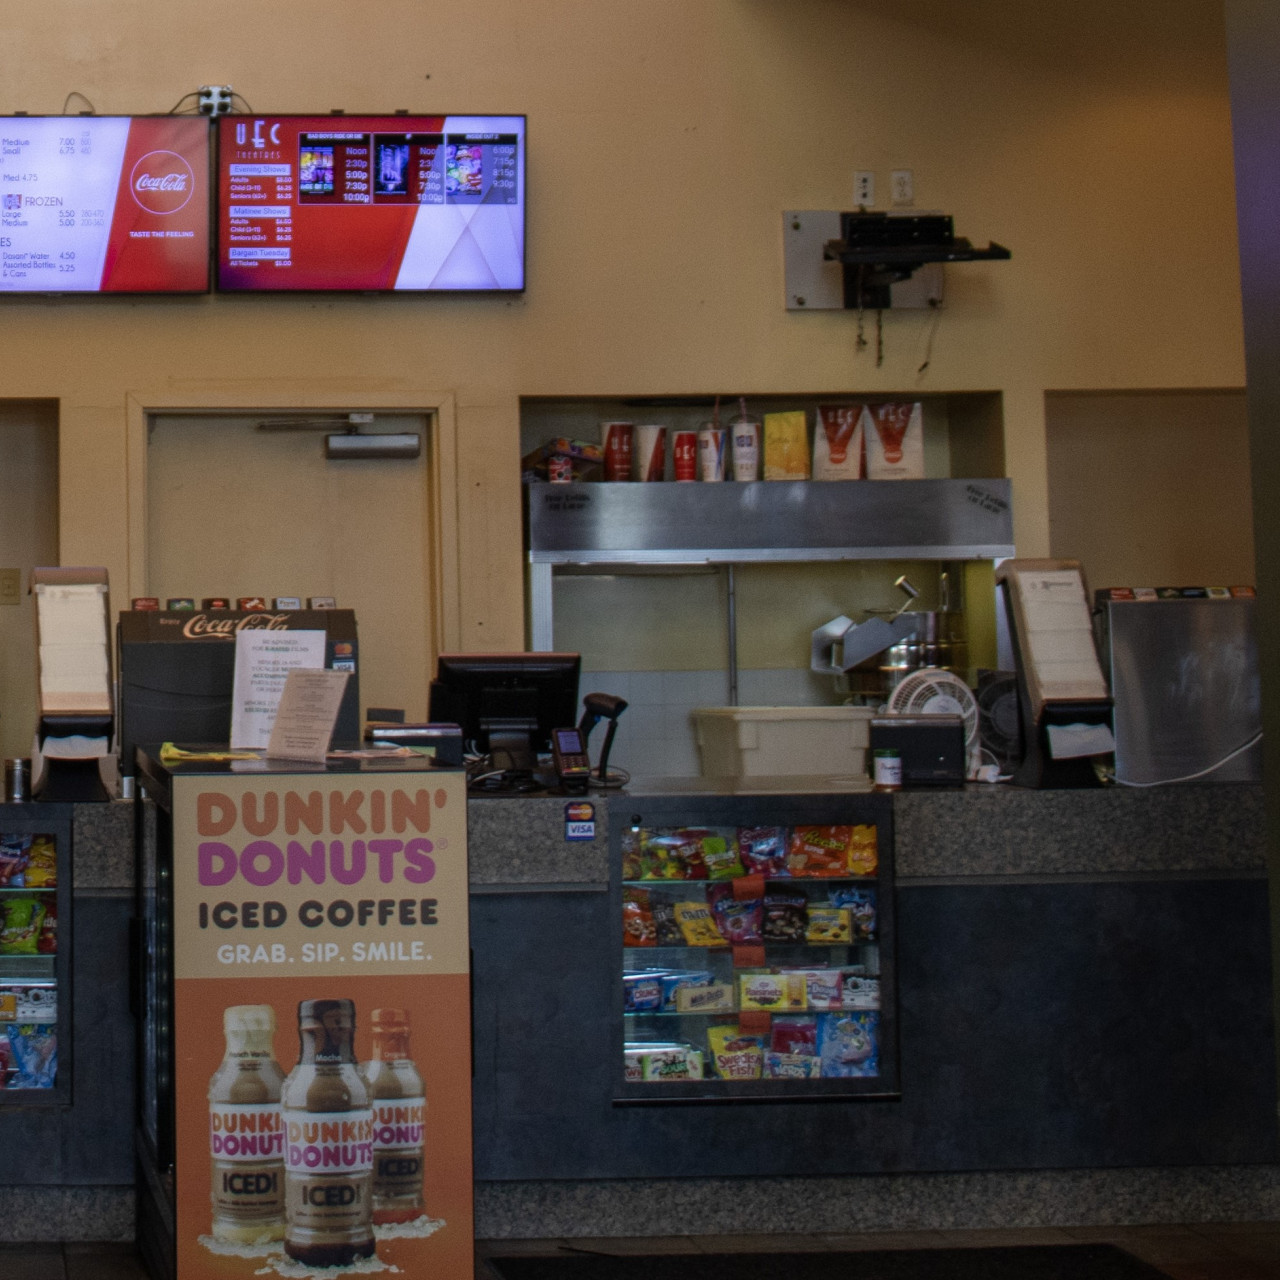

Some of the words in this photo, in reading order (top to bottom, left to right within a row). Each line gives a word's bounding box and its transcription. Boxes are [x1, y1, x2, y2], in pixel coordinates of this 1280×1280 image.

[2, 138, 30, 146] Medium
[346, 147, 368, 155] Noon
[346, 159, 368, 168] 2:30p
[346, 170, 368, 180] 5:00p
[346, 181, 368, 191] 7:30p
[25, 197, 63, 206] FROZEN
[232, 249, 258, 257] Bargain
[260, 249, 288, 257] Tuesday
[3, 261, 31, 269] Assorted
[33, 261, 56, 269] Bottles
[197, 789, 447, 837] DUNKIN'
[570, 824, 593, 834] VISA
[199, 901, 288, 929] ICED
[298, 898, 439, 928] COFFEE
[217, 943, 295, 965] GRAB.
[301, 943, 345, 964] SIP.
[352, 941, 432, 963] SMILE.
[315, 1054, 342, 1062] Mocha
